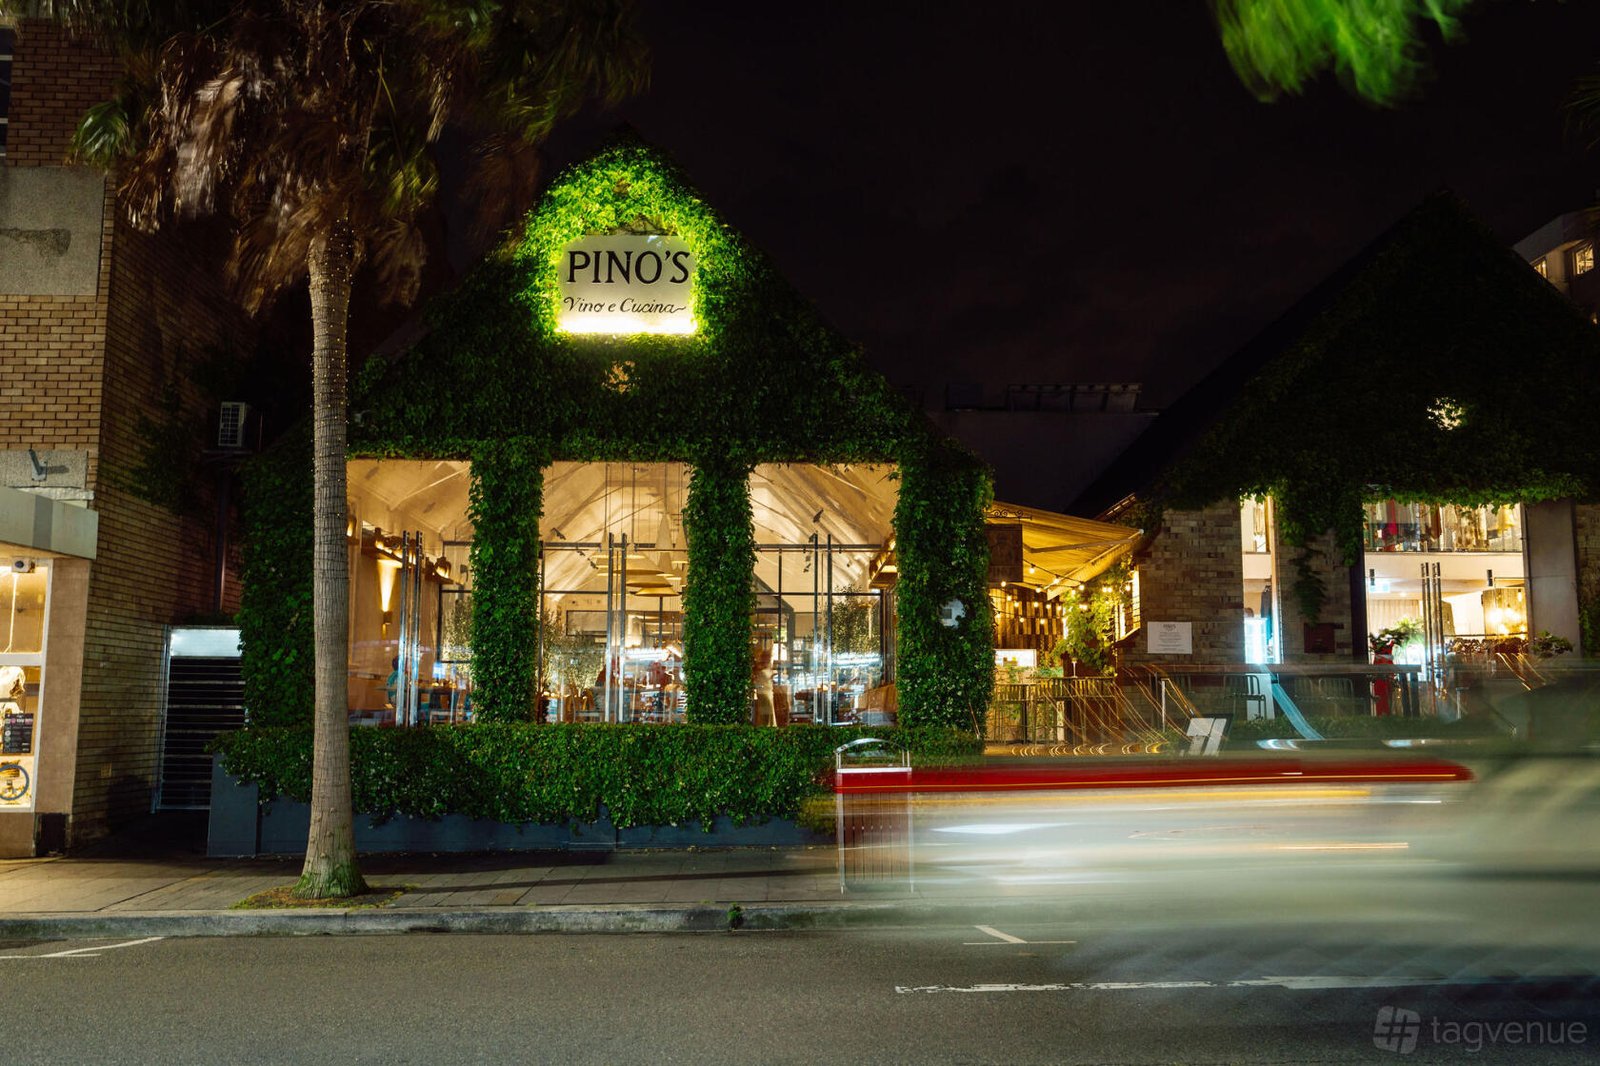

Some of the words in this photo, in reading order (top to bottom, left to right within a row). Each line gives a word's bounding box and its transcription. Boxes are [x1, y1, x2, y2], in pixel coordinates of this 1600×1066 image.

[566, 250, 691, 284] PINO'S
[563, 296, 606, 313] Vino
[607, 301, 616, 312] e
[620, 297, 687, 314] Cucina
